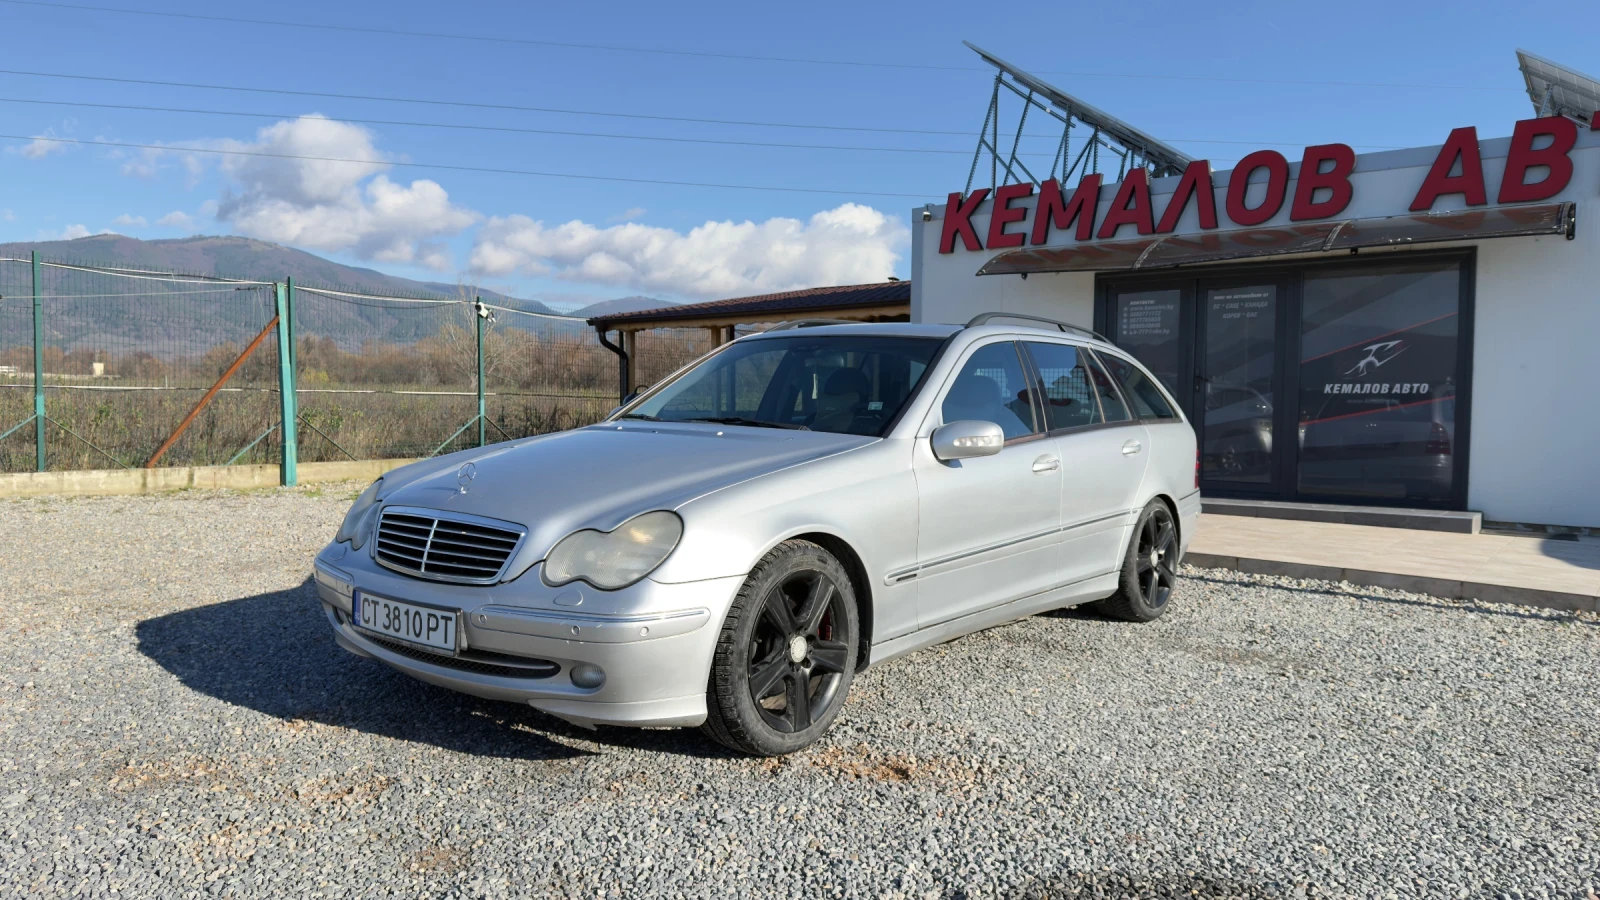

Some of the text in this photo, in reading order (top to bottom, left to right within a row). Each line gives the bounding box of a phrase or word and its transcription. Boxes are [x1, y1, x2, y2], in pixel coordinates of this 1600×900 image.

[939, 110, 1600, 254] КЕМАЛОВ АВ
[1324, 383, 1429, 394] КЕМАЛОВ АВТО
[382, 604, 422, 638] 3810
